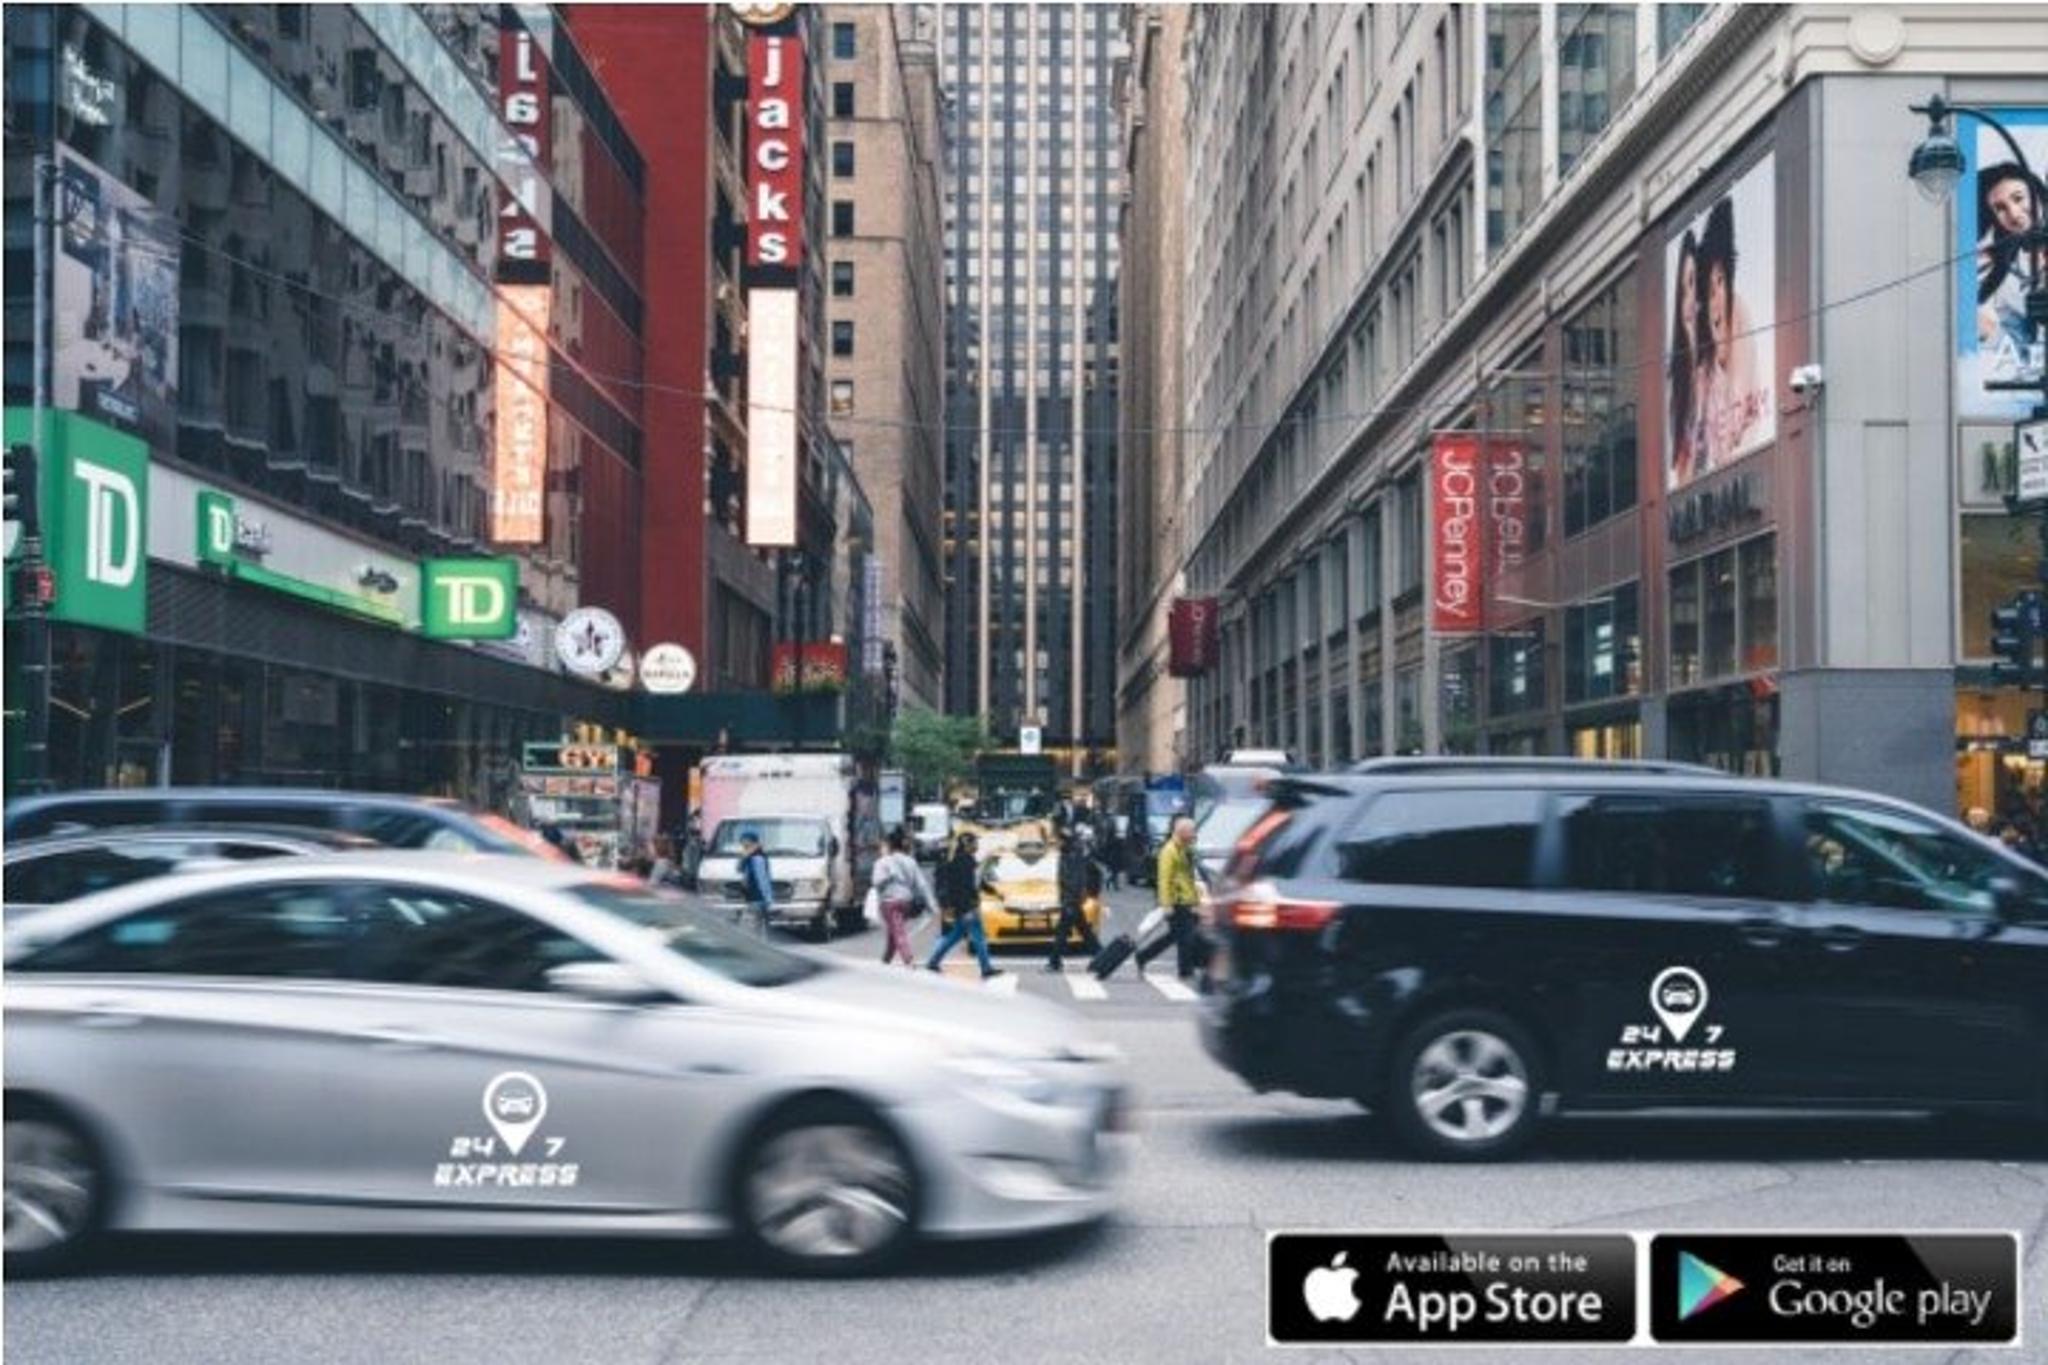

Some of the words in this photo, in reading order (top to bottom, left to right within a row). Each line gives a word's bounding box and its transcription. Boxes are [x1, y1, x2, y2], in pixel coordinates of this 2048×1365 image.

[756, 37, 790, 263] jacks
[73, 457, 141, 588] TD
[1436, 450, 1476, 619] JCPenney
[434, 576, 506, 624] TD
[1621, 1025, 1662, 1044] 24
[1705, 1025, 1725, 1044] 7
[1606, 1049, 1736, 1072] EXPRESS
[450, 1137, 495, 1158] 24
[545, 1137, 566, 1157] 7
[434, 1163, 579, 1187] EXPRESS
